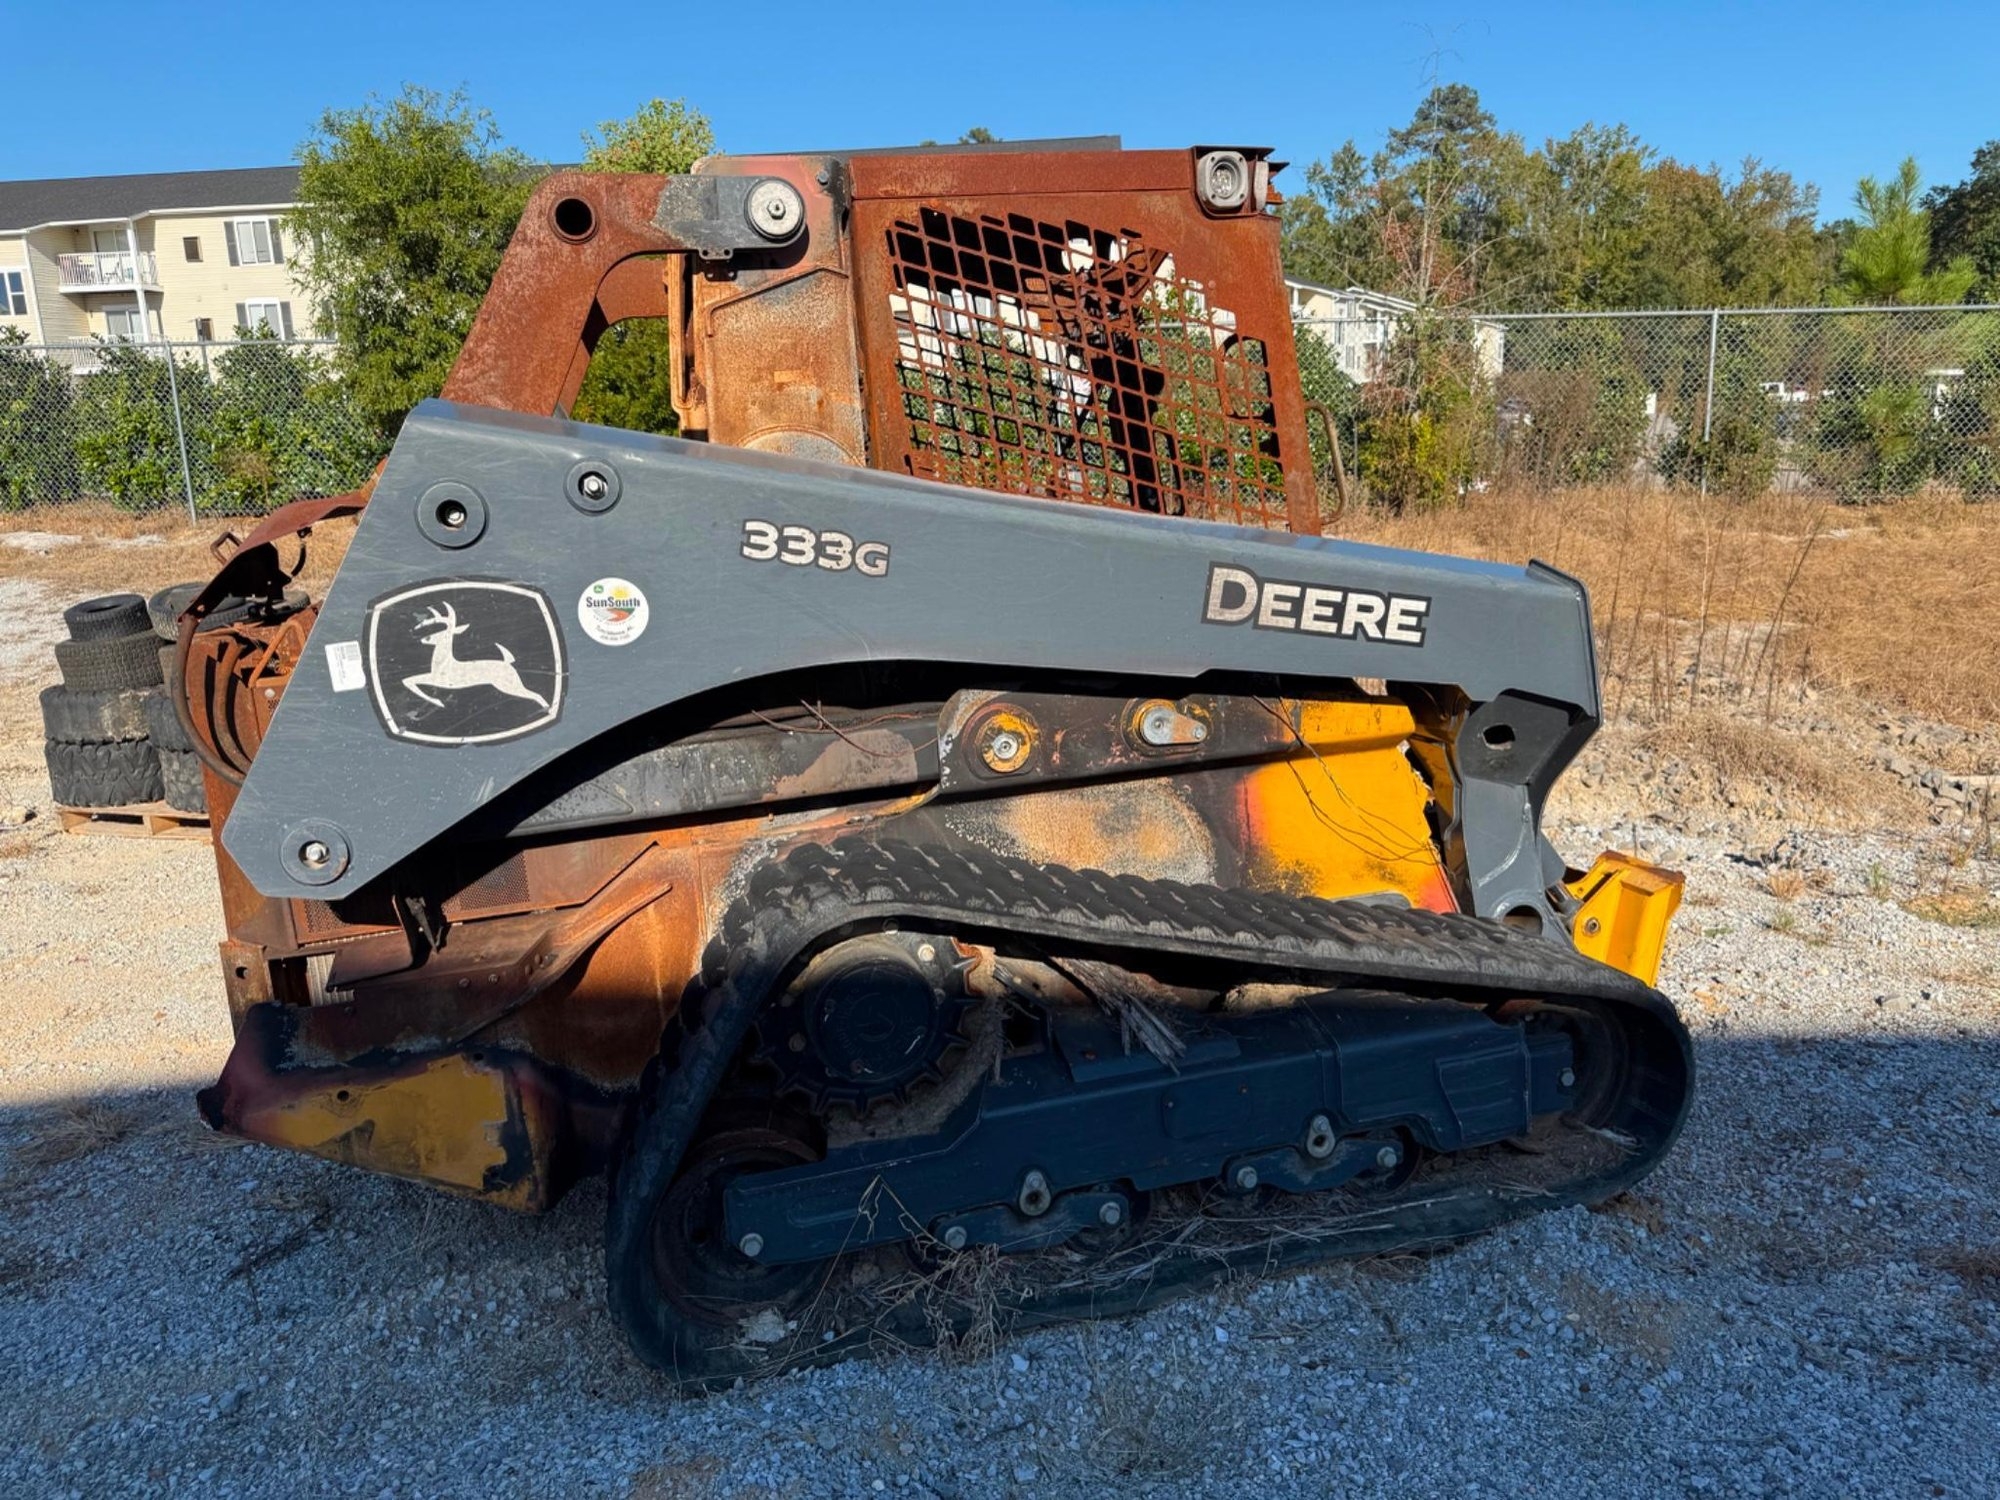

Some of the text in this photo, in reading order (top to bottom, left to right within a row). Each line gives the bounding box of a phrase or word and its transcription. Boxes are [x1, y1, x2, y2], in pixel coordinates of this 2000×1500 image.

[741, 519, 890, 577] 333G
[586, 596, 640, 608] SunSouth
[1204, 564, 1430, 645] DEERE
